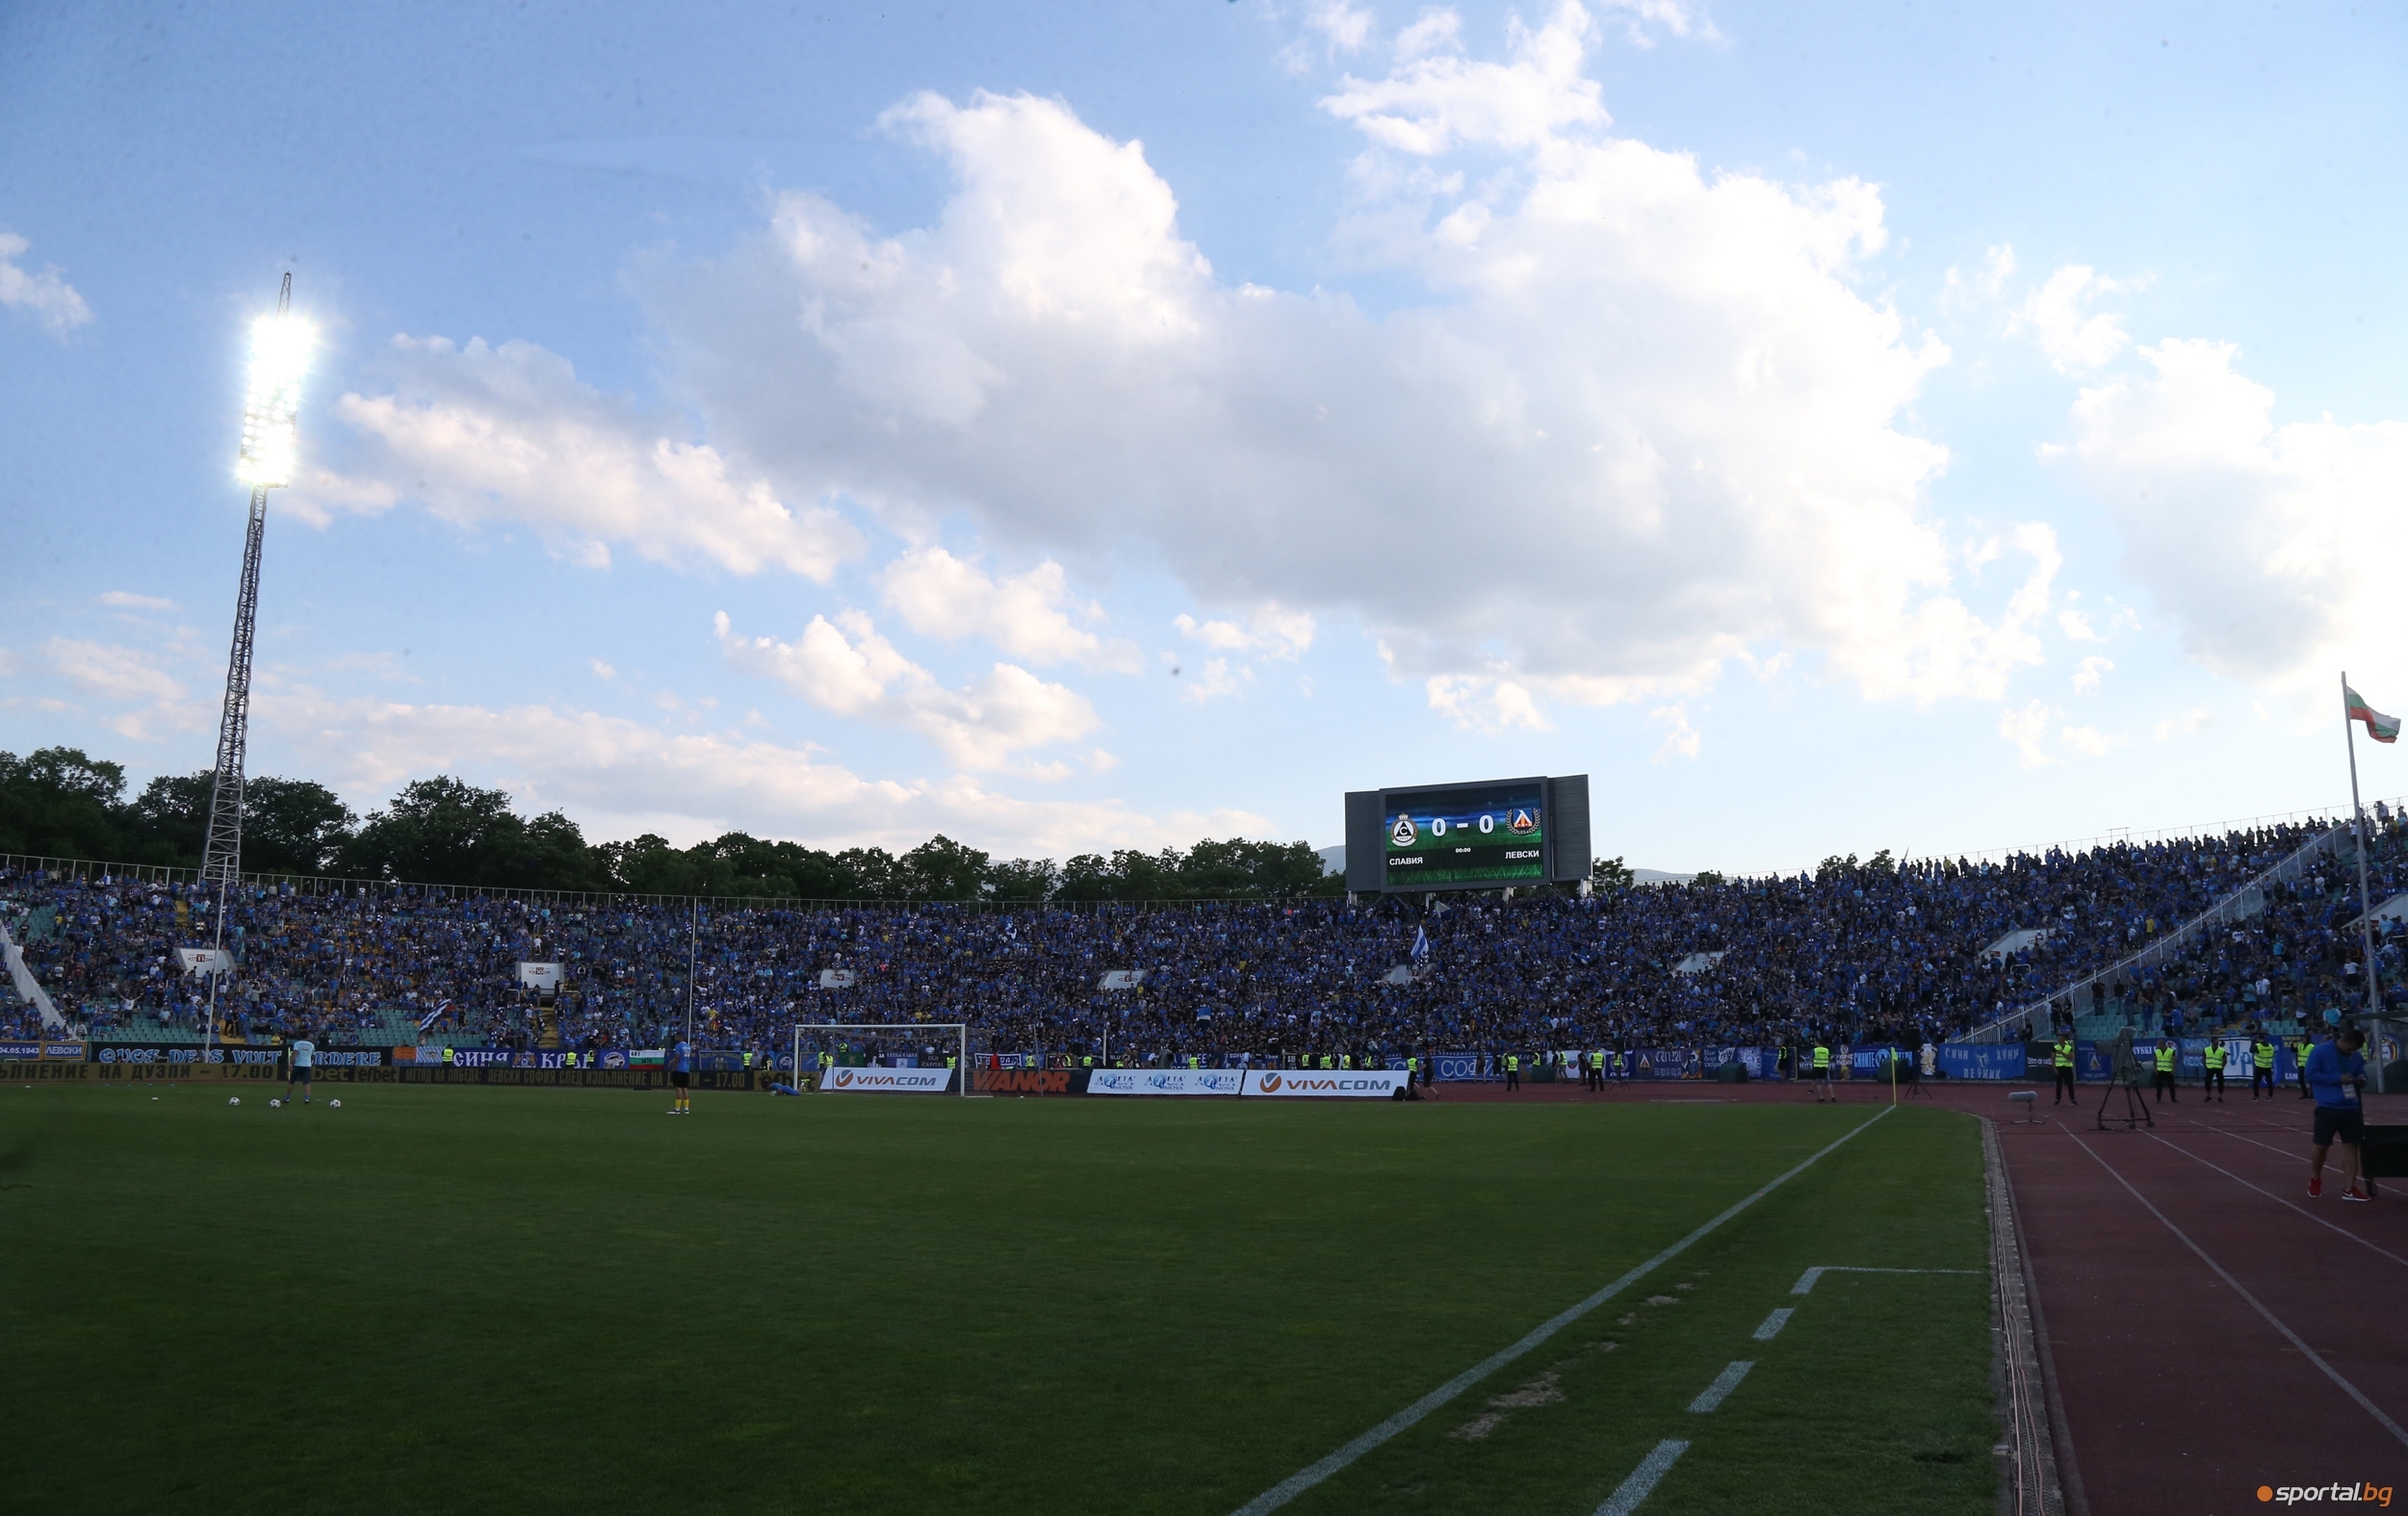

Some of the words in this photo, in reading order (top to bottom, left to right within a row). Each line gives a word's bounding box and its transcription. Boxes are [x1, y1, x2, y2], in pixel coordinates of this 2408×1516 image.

[1432, 818, 1446, 836] 0
[1479, 814, 1494, 834] 0
[1389, 857, 1423, 866] СЛАВИЯ
[1505, 850, 1540, 860] ЛЕВСКИ
[45, 1045, 83, 1055] ЛЕВСКИ
[168, 1049, 223, 1064] DES
[231, 1049, 282, 1066] VULT
[1945, 1046, 1969, 1060] СИНИ
[1996, 1047, 2020, 1061] ХУНИ
[2132, 1045, 2153, 1055] EVSKI
[98, 1065, 122, 1079] НА
[131, 1065, 192, 1081] ДУЗПИ
[221, 1065, 273, 1080] 17.00
[1440, 1060, 1503, 1077] СОФИ
[1963, 1068, 2001, 1080] ПЕРНИК
[405, 1068, 432, 1083] МЕТОД
[434, 1068, 445, 1082] НА
[448, 1068, 481, 1083] ПОБЕДА:
[487, 1068, 520, 1084] ЛЕВСКИ
[524, 1069, 556, 1085] СОФИЯ
[559, 1070, 583, 1086] СЛЕД
[586, 1070, 647, 1086] ИЗПЪЛНЕНИЕ
[651, 1071, 663, 1086] НА
[666, 1071, 700, 1089] ДПИ
[715, 1072, 745, 1088] 17.00
[857, 1076, 937, 1087] VIVACOM
[1095, 1074, 1134, 1089] AQUA
[1144, 1074, 1184, 1089] AQUA
[1195, 1074, 1236, 1089] AQUA
[1286, 1080, 1391, 1091] VIVACOM
